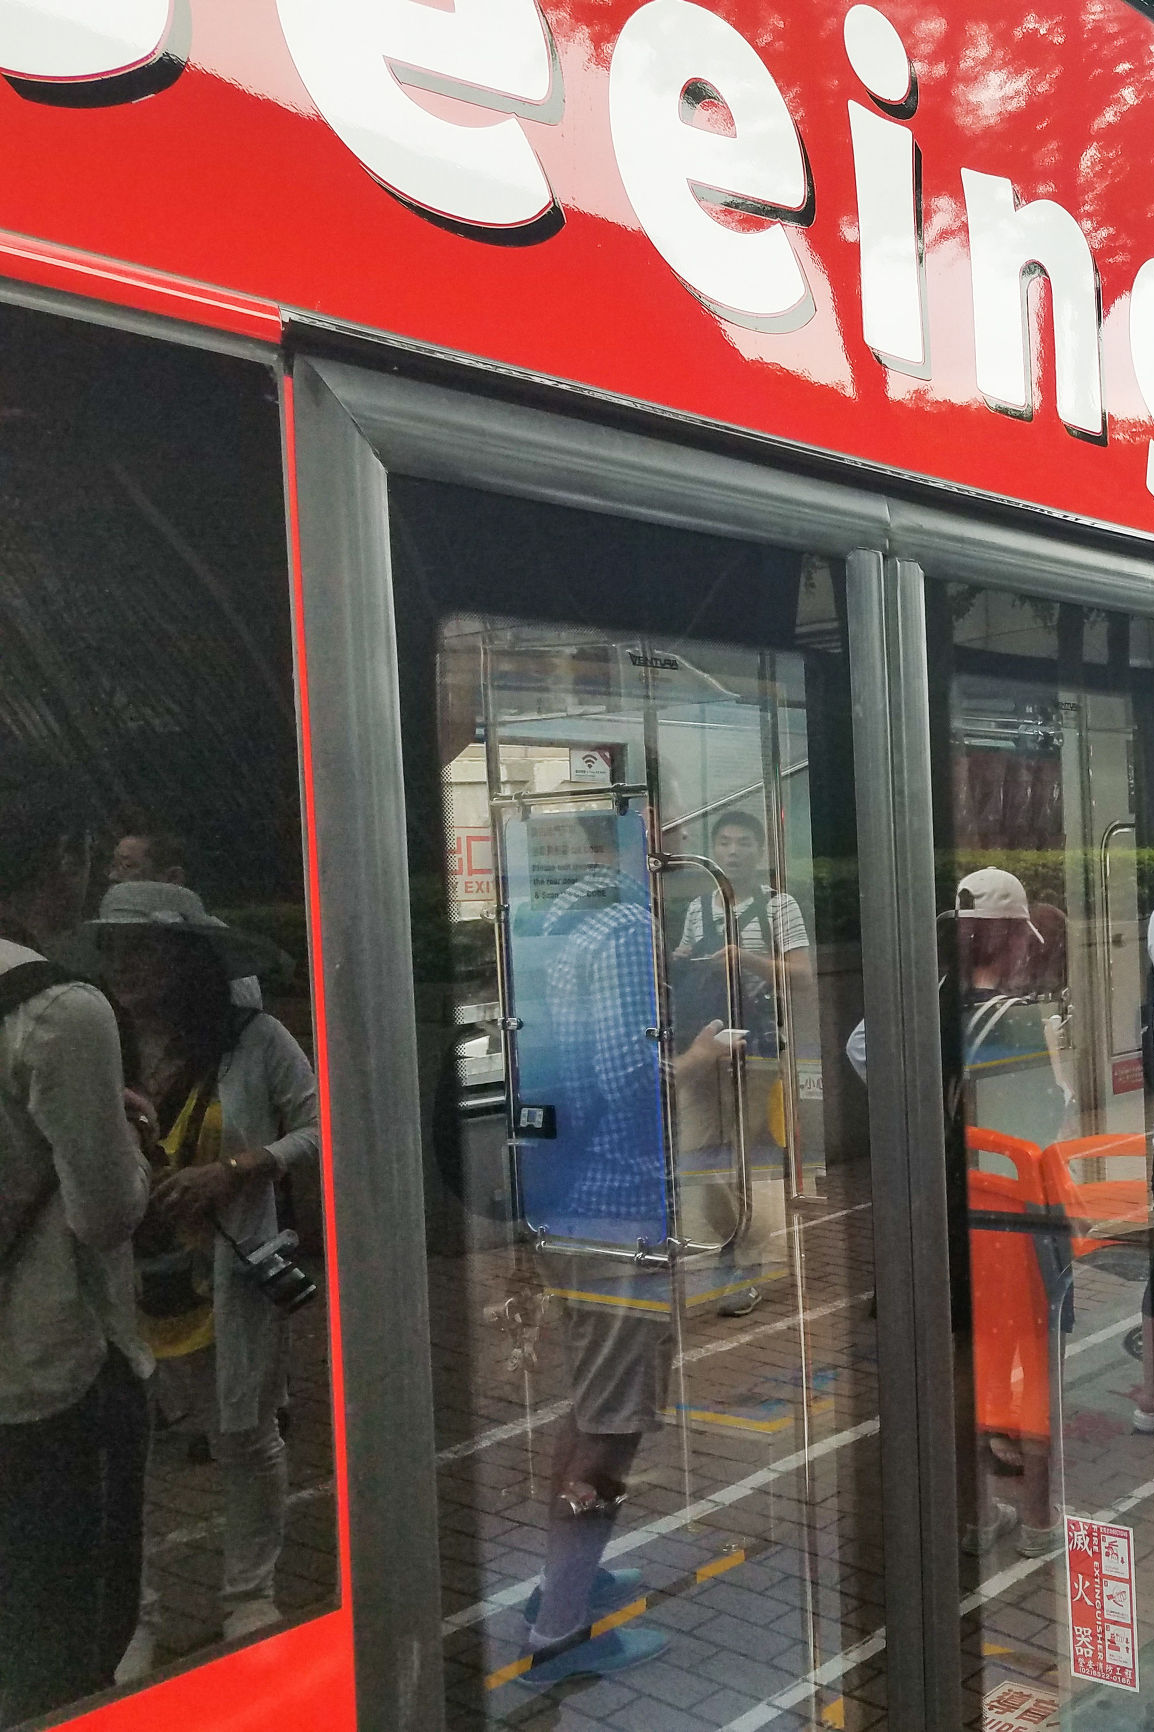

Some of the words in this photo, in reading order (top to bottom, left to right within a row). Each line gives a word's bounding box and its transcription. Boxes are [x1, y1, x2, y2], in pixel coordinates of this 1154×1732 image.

[628, 651, 679, 670] VENTURA
[464, 881, 497, 894] EXI
[1091, 1524, 1100, 1553] FIRE
[1068, 1522, 1096, 1658] 滅火器
[1093, 1561, 1105, 1660] EXTINGUISHER
